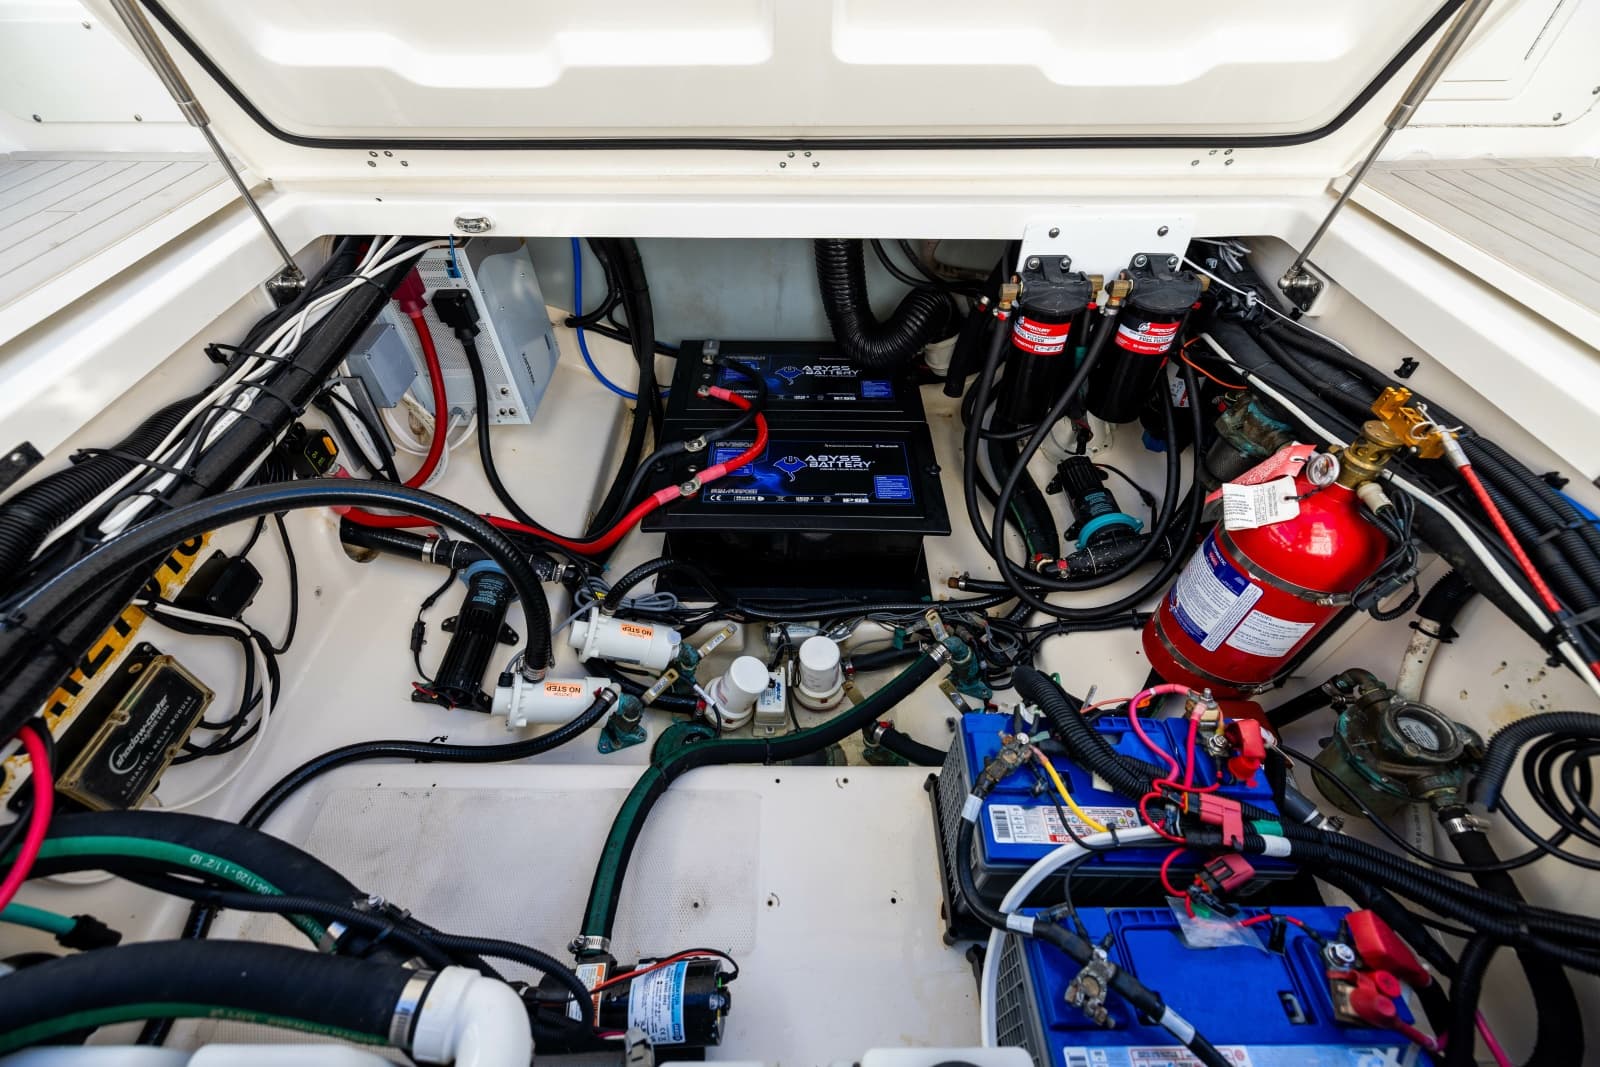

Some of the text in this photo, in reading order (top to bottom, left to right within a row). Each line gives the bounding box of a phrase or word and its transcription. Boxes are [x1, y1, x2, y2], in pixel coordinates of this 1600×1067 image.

[622, 626, 641, 634] STEP
[546, 685, 567, 693] STEP
[125, 751, 155, 788] CHANNEL
[152, 725, 172, 750] RELAY
[169, 695, 193, 726] MODULE
[189, 853, 204, 865] ID
